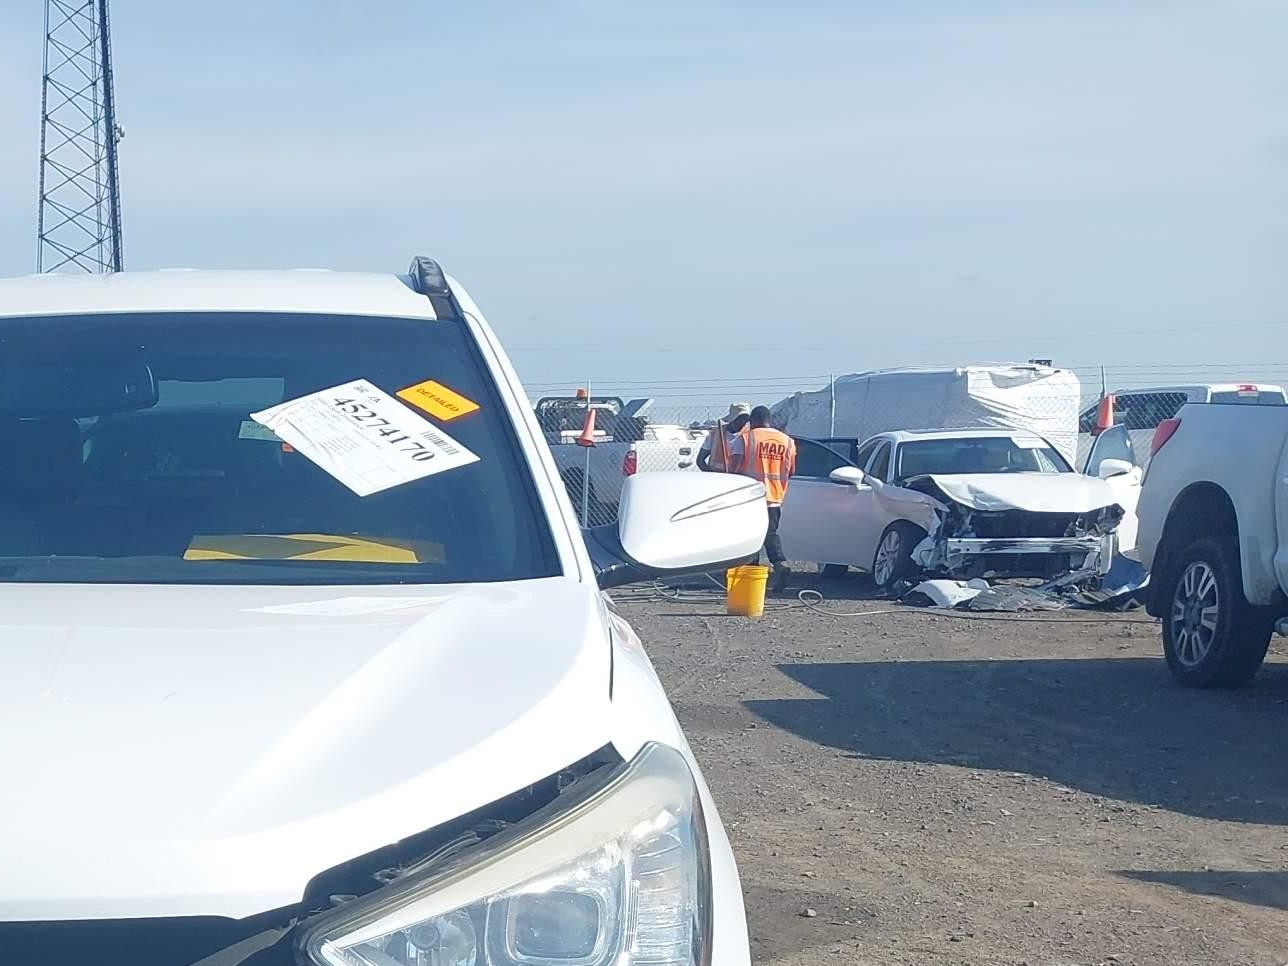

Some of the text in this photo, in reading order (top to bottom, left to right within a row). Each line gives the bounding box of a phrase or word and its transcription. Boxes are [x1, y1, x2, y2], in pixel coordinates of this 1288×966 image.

[415, 387, 460, 413] DETAILED
[333, 397, 435, 462] 45274170
[759, 441, 785, 456] MAD
